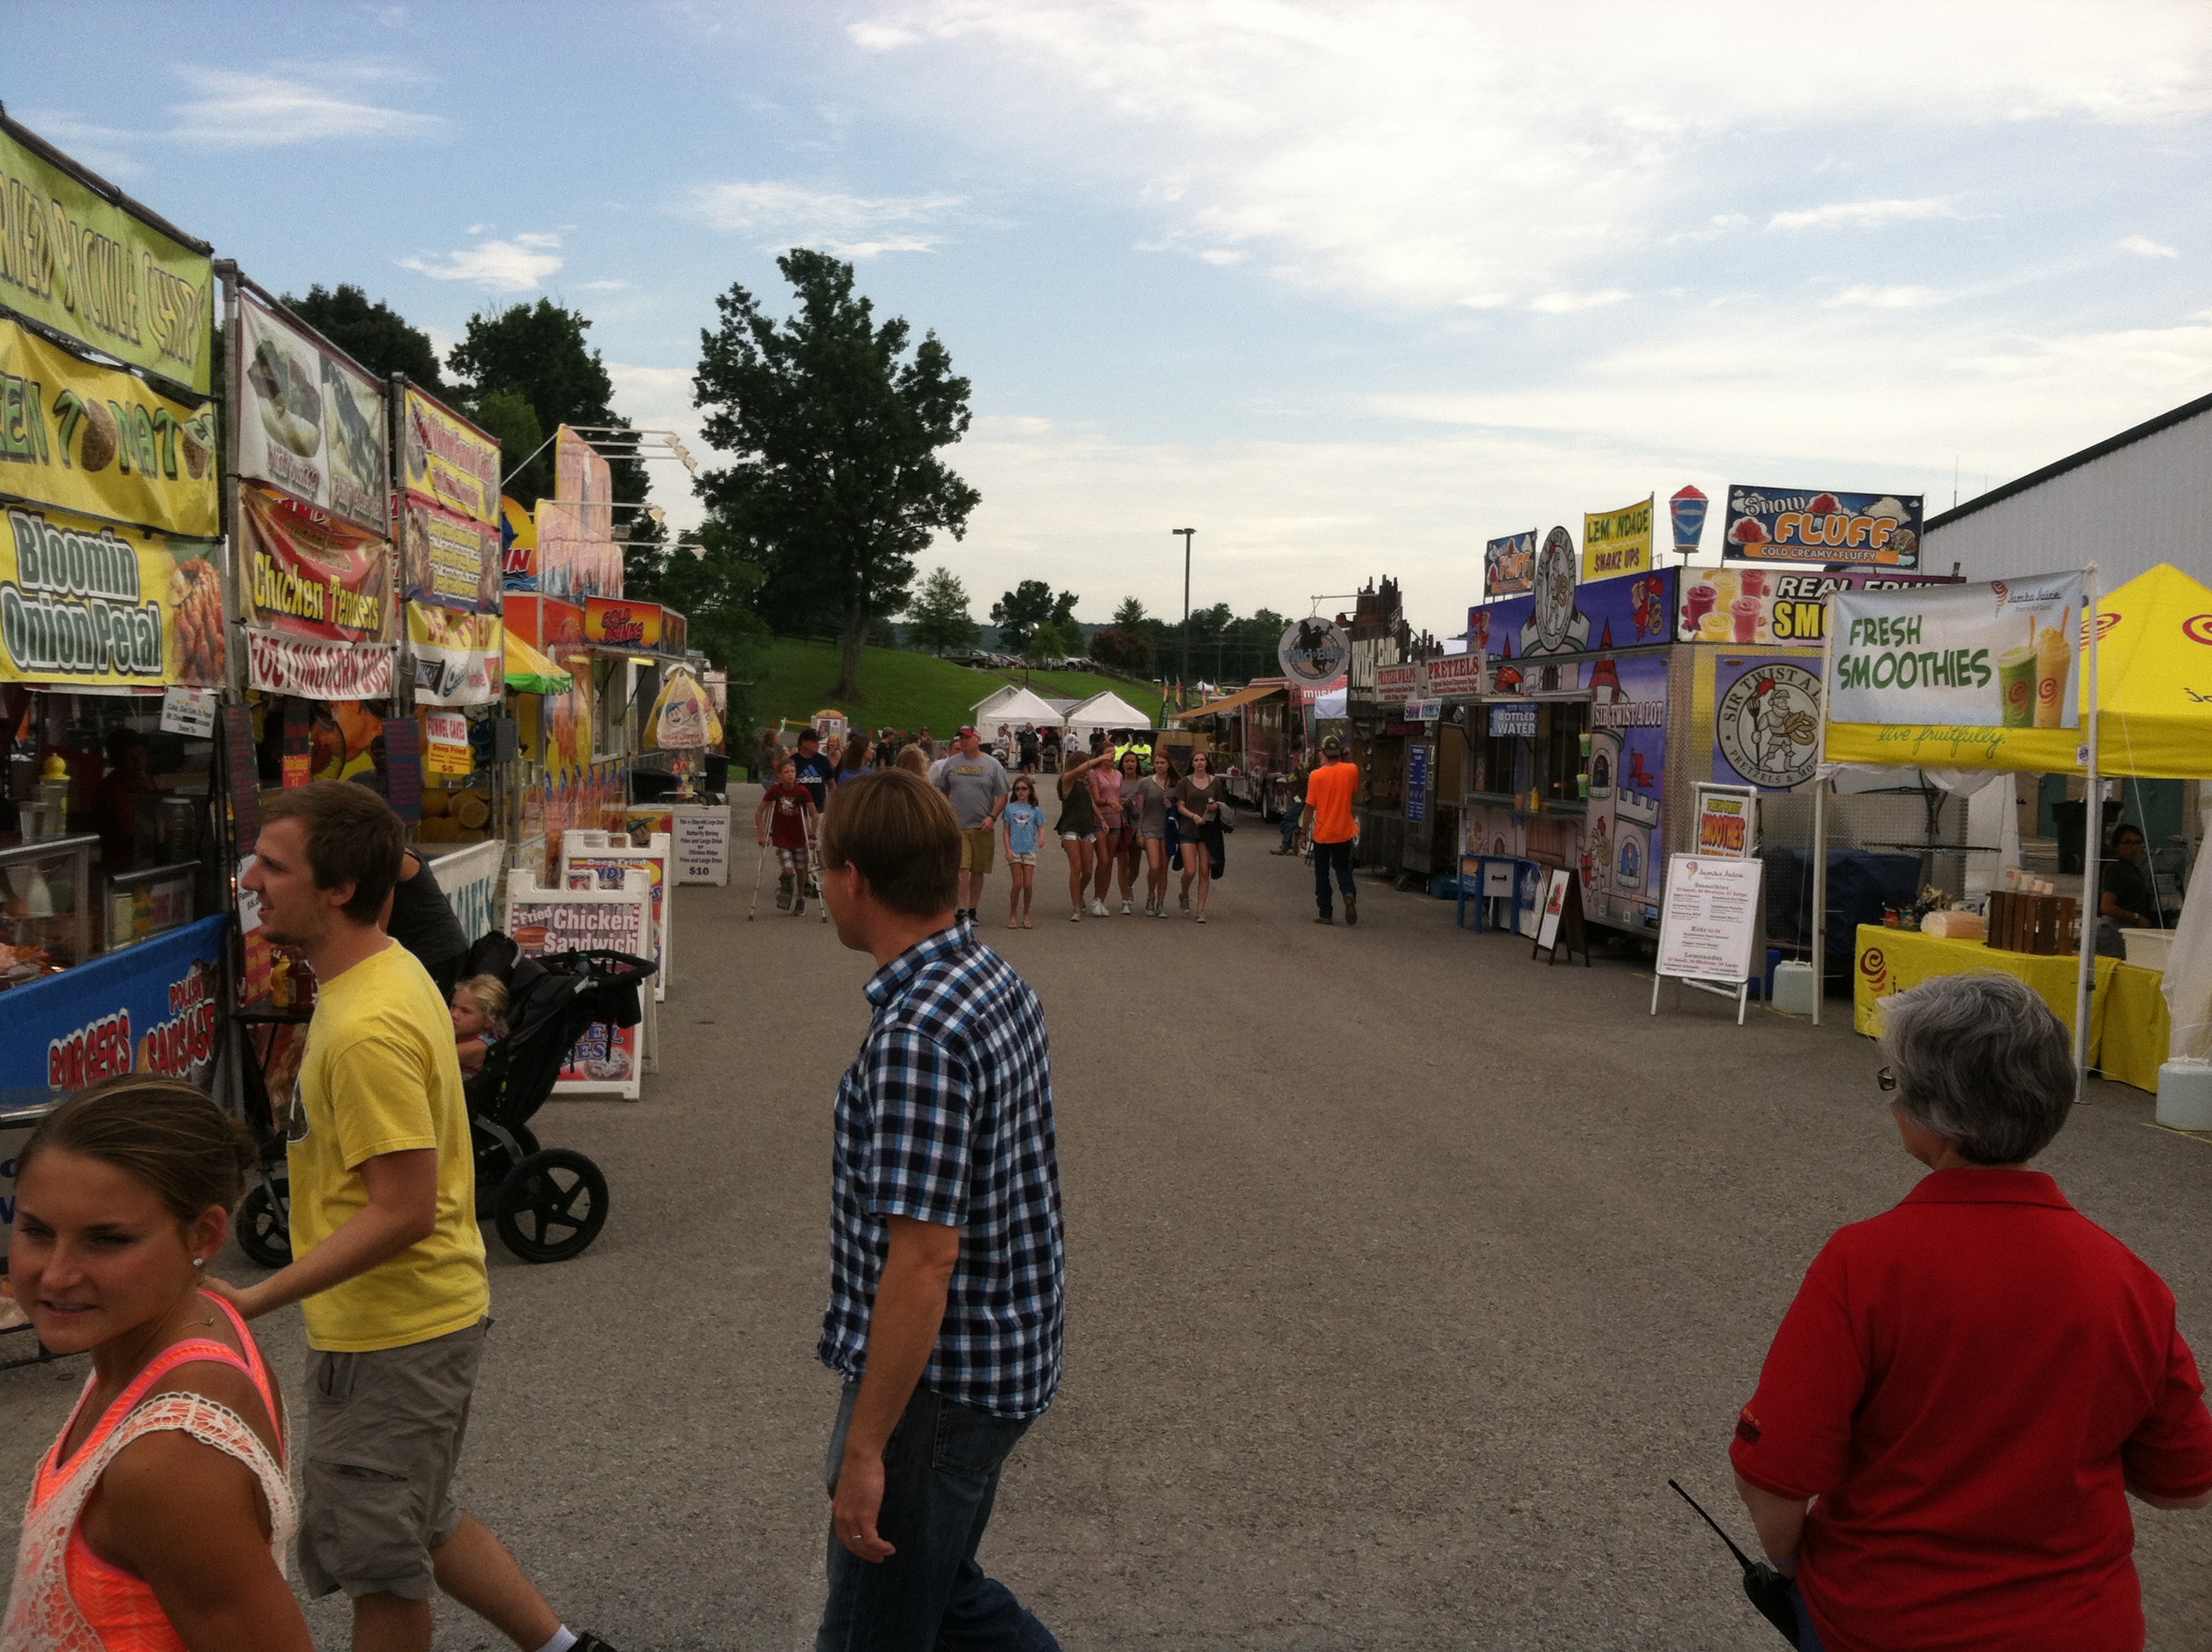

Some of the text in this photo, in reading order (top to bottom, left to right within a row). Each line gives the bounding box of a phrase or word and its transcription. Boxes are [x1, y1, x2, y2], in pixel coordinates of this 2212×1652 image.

[0, 371, 50, 468] EN
[1744, 496, 1807, 515] Snow
[1774, 512, 1896, 550] FLUFF
[10, 509, 139, 602] Bloomin
[1594, 548, 1640, 573] SHAKE UPS
[1761, 546, 1789, 556] COLD
[253, 551, 324, 622] Chicken
[1778, 577, 1850, 598] REAL
[1, 583, 163, 674] Onion Petal
[1849, 614, 1923, 648] FRESH
[1427, 656, 1481, 680] PRETZELS
[1837, 649, 1993, 690] SMOOTHIES
[1725, 693, 1743, 723] SIR
[1741, 667, 1798, 692] TWIST
[1799, 678, 1811, 690] A
[1499, 712, 1535, 721] BOTTLED
[1595, 703, 1610, 727] SIR
[1610, 702, 1637, 728] TWIST
[1644, 701, 1663, 726] LOT
[1498, 723, 1535, 734] WATER
[1877, 724, 1909, 742] live
[1729, 749, 1782, 784] PRETZELS
[796, 776, 823, 784] adidas
[1700, 813, 1746, 852] SMOOTHIES
[689, 866, 710, 875] $10
[518, 905, 636, 931] Fried Chicken
[544, 932, 637, 957] Sandwich
[48, 1008, 131, 1091] BURGERS
